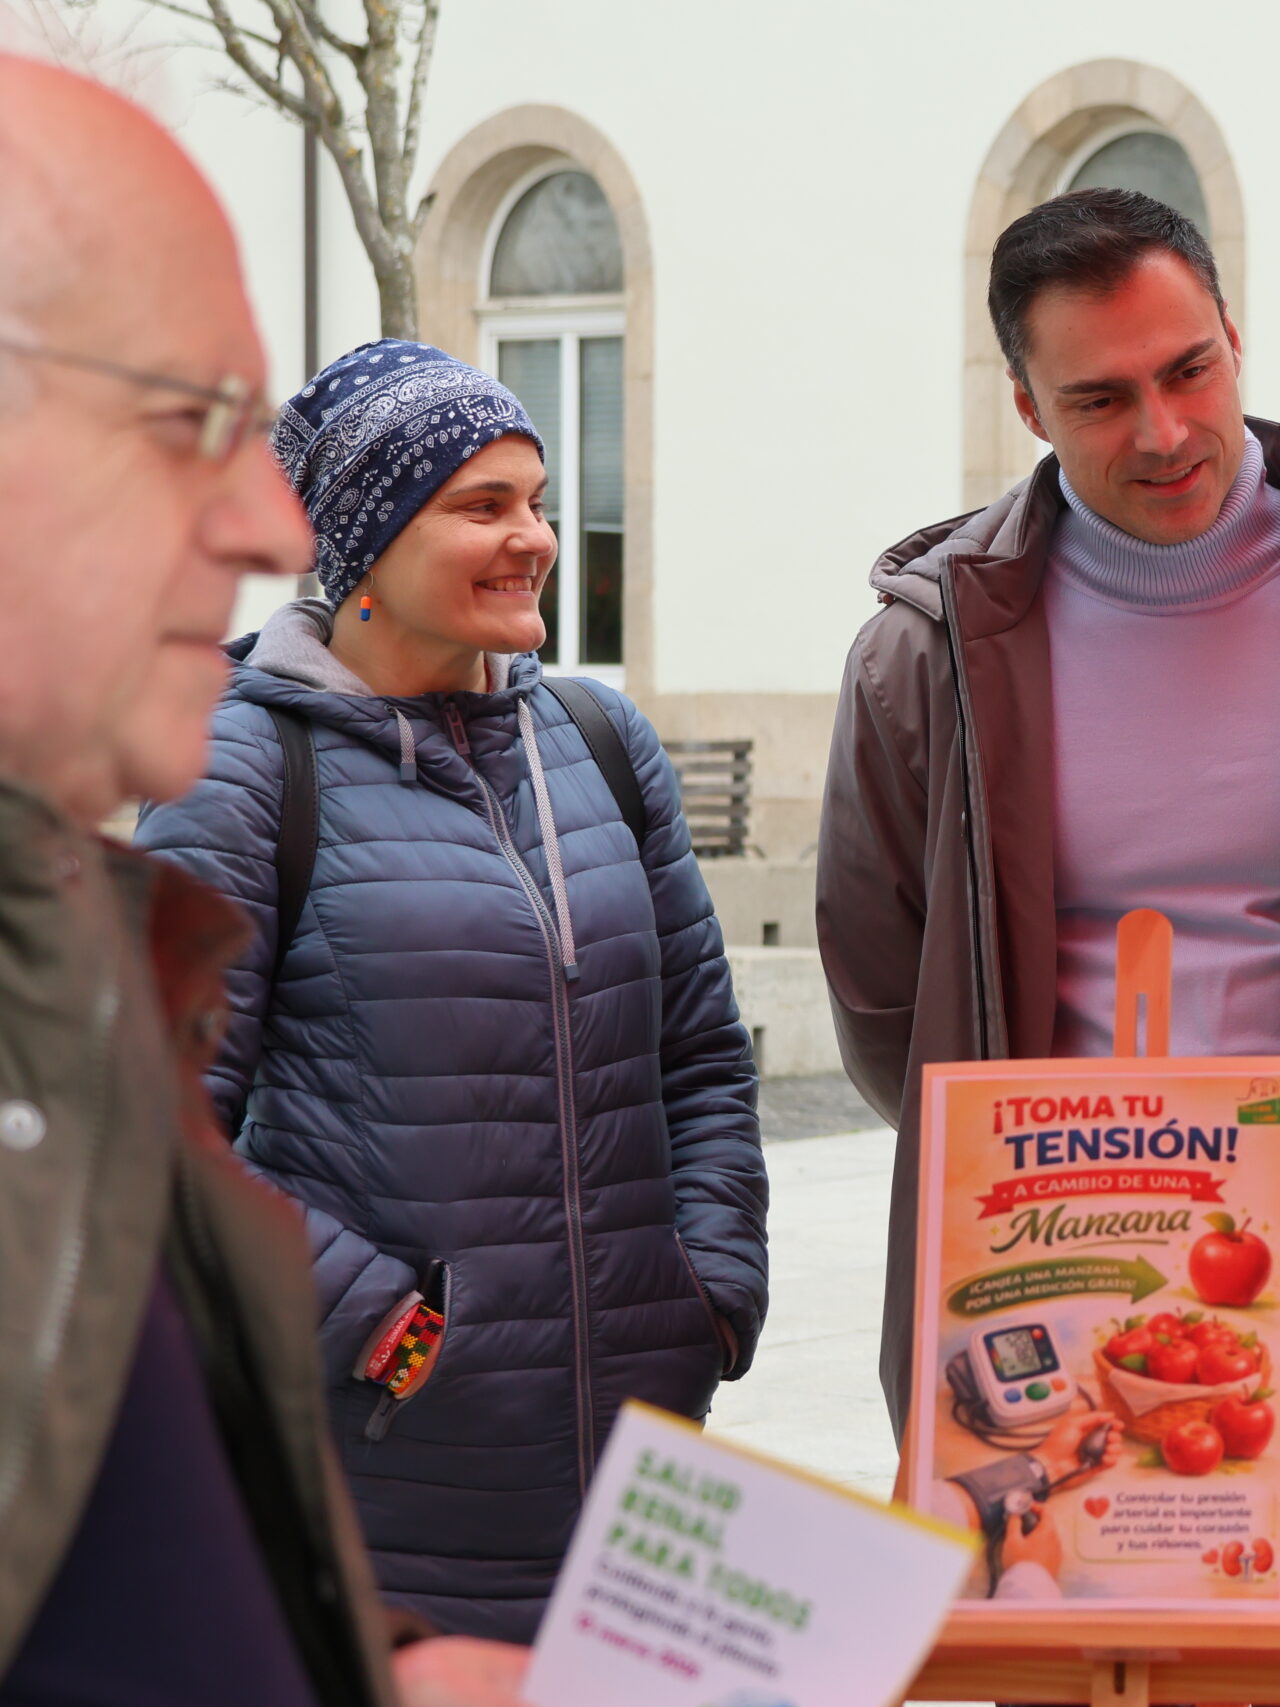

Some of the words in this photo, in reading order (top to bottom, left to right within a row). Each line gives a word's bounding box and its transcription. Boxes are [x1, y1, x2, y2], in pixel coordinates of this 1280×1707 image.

[993, 1095, 1115, 1134] ¡TOMA
[1123, 1095, 1163, 1118] TU
[1004, 1118, 1239, 1170] TENSIÓN!
[1013, 1184, 1028, 1198] A
[1033, 1174, 1113, 1195] CAMBIO
[1118, 1174, 1143, 1189] DE
[1150, 1175, 1191, 1190] UNA
[989, 1203, 1192, 1253] Manzana
[1025, 1269, 1052, 1283] UNA
[1054, 1265, 1121, 1278] MANZANA
[965, 1295, 992, 1311] POR
[995, 1289, 1022, 1302] UNA
[1024, 1279, 1085, 1296] MEDICIÓN
[1088, 1277, 1137, 1290] GRATIS!
[635, 1449, 742, 1514] SALUD
[1116, 1491, 1176, 1504] Controlar
[1180, 1492, 1194, 1503] tu
[620, 1486, 724, 1550] RENAL
[1100, 1524, 1131, 1536] para
[1133, 1522, 1174, 1533] cuidar
[1179, 1523, 1193, 1533] tu
[1113, 1507, 1159, 1518] arterial
[1180, 1507, 1252, 1519] importante
[1128, 1539, 1148, 1549] tus
[607, 1522, 694, 1579] PARA
[708, 1561, 814, 1631] TODOS
